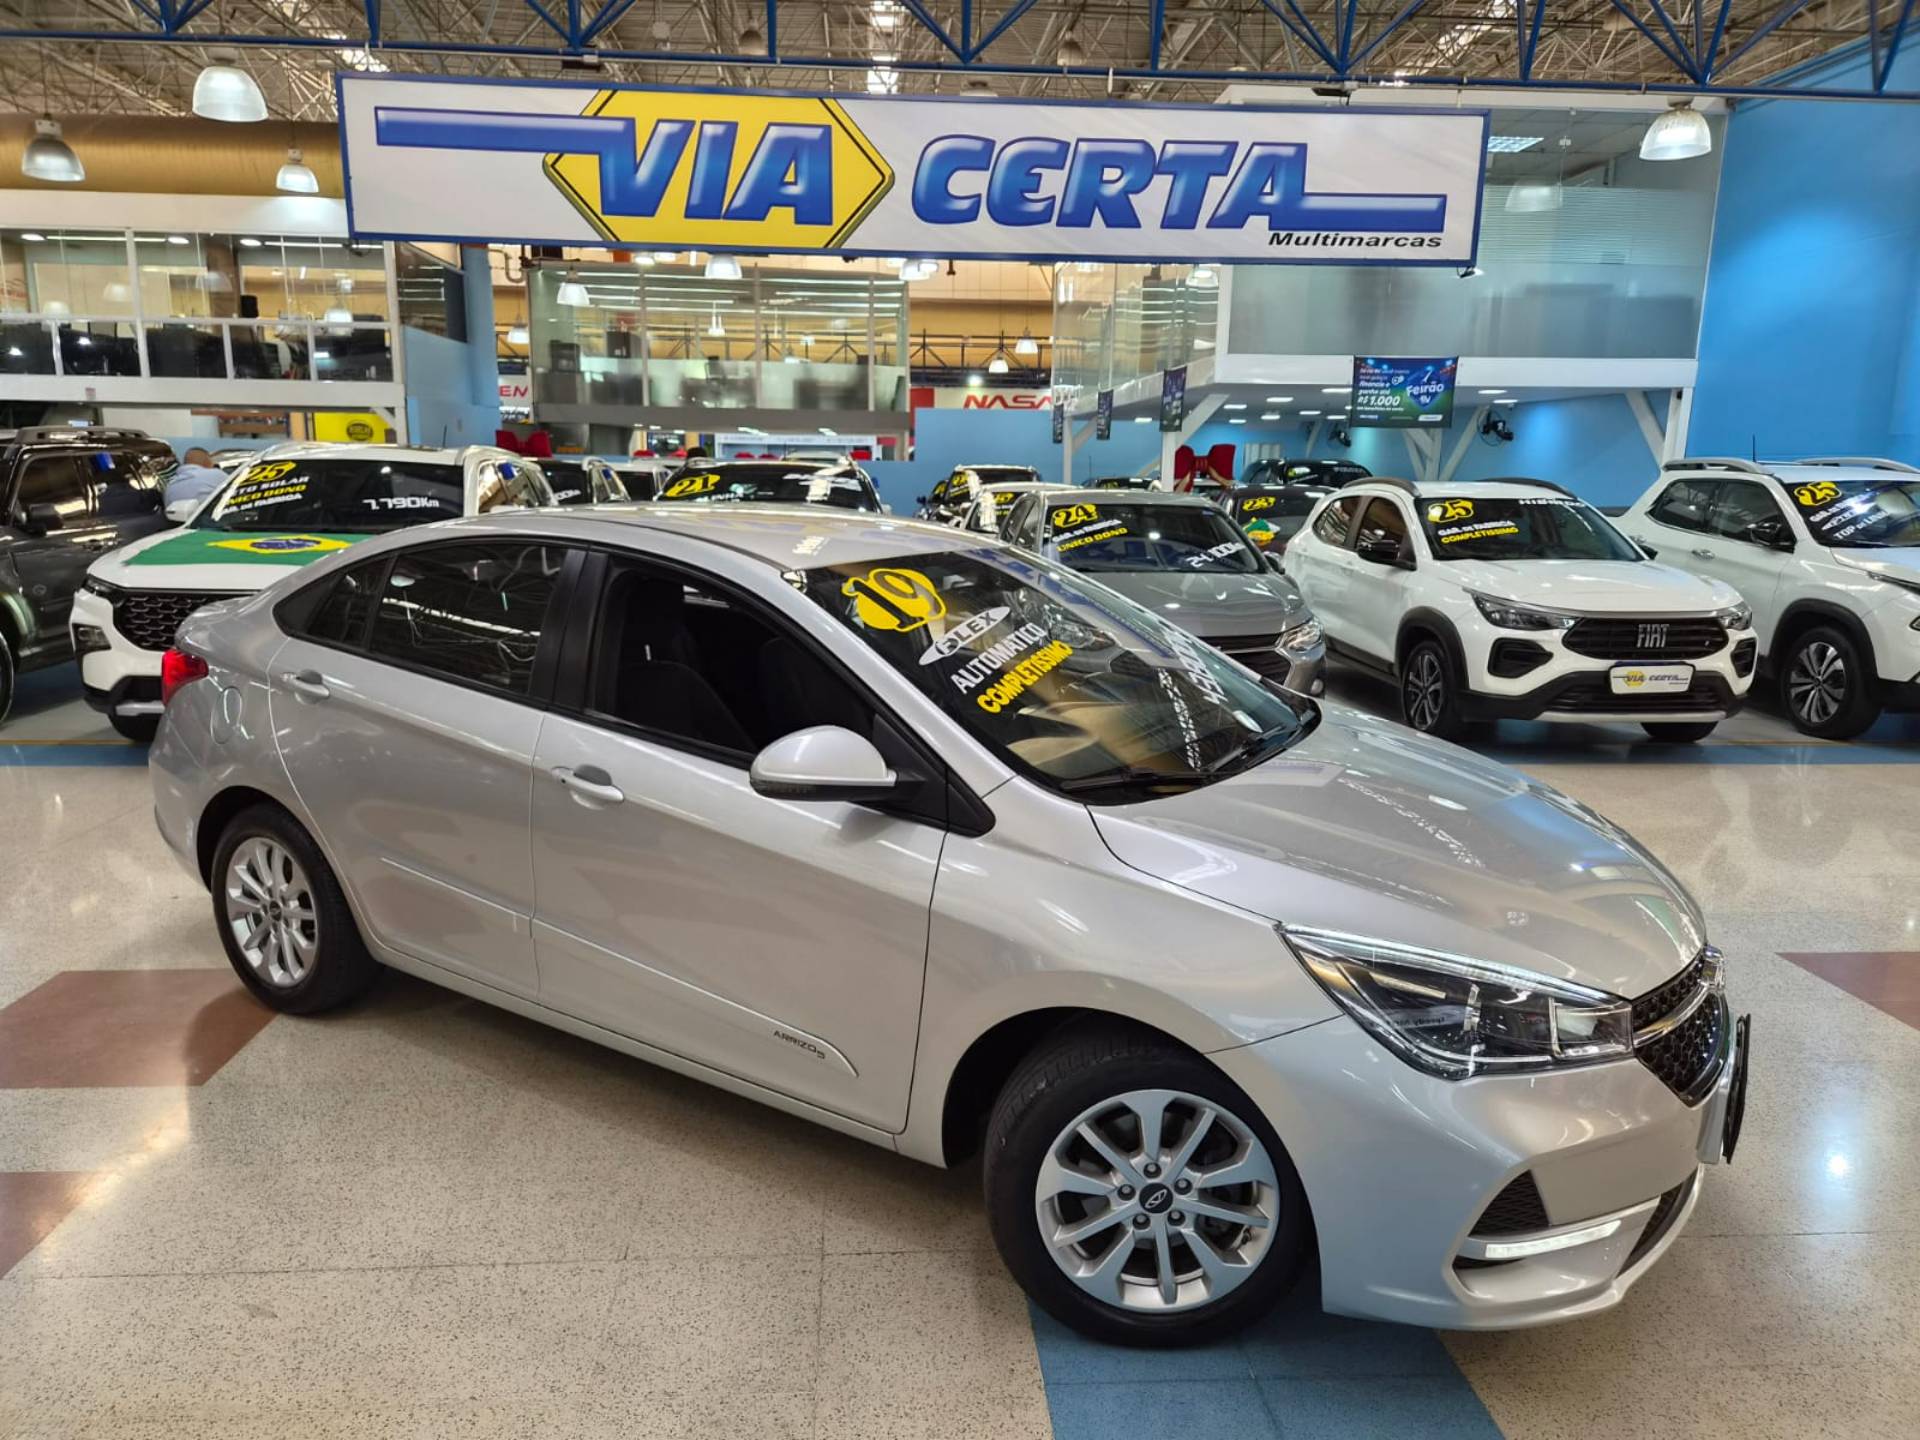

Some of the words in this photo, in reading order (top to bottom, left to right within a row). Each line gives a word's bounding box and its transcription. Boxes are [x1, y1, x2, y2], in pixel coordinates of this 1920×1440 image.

[911, 134, 1308, 230] CERTA
[1268, 231, 1443, 248] Multimarcas
[1370, 395, 1401, 407] 1.000
[1430, 501, 1472, 522] 25
[934, 610, 999, 657] FLEX
[1637, 624, 1670, 648] FIAT
[950, 622, 1048, 695] AUTOMATICO
[976, 638, 1074, 714] COMPLETISSIMO
